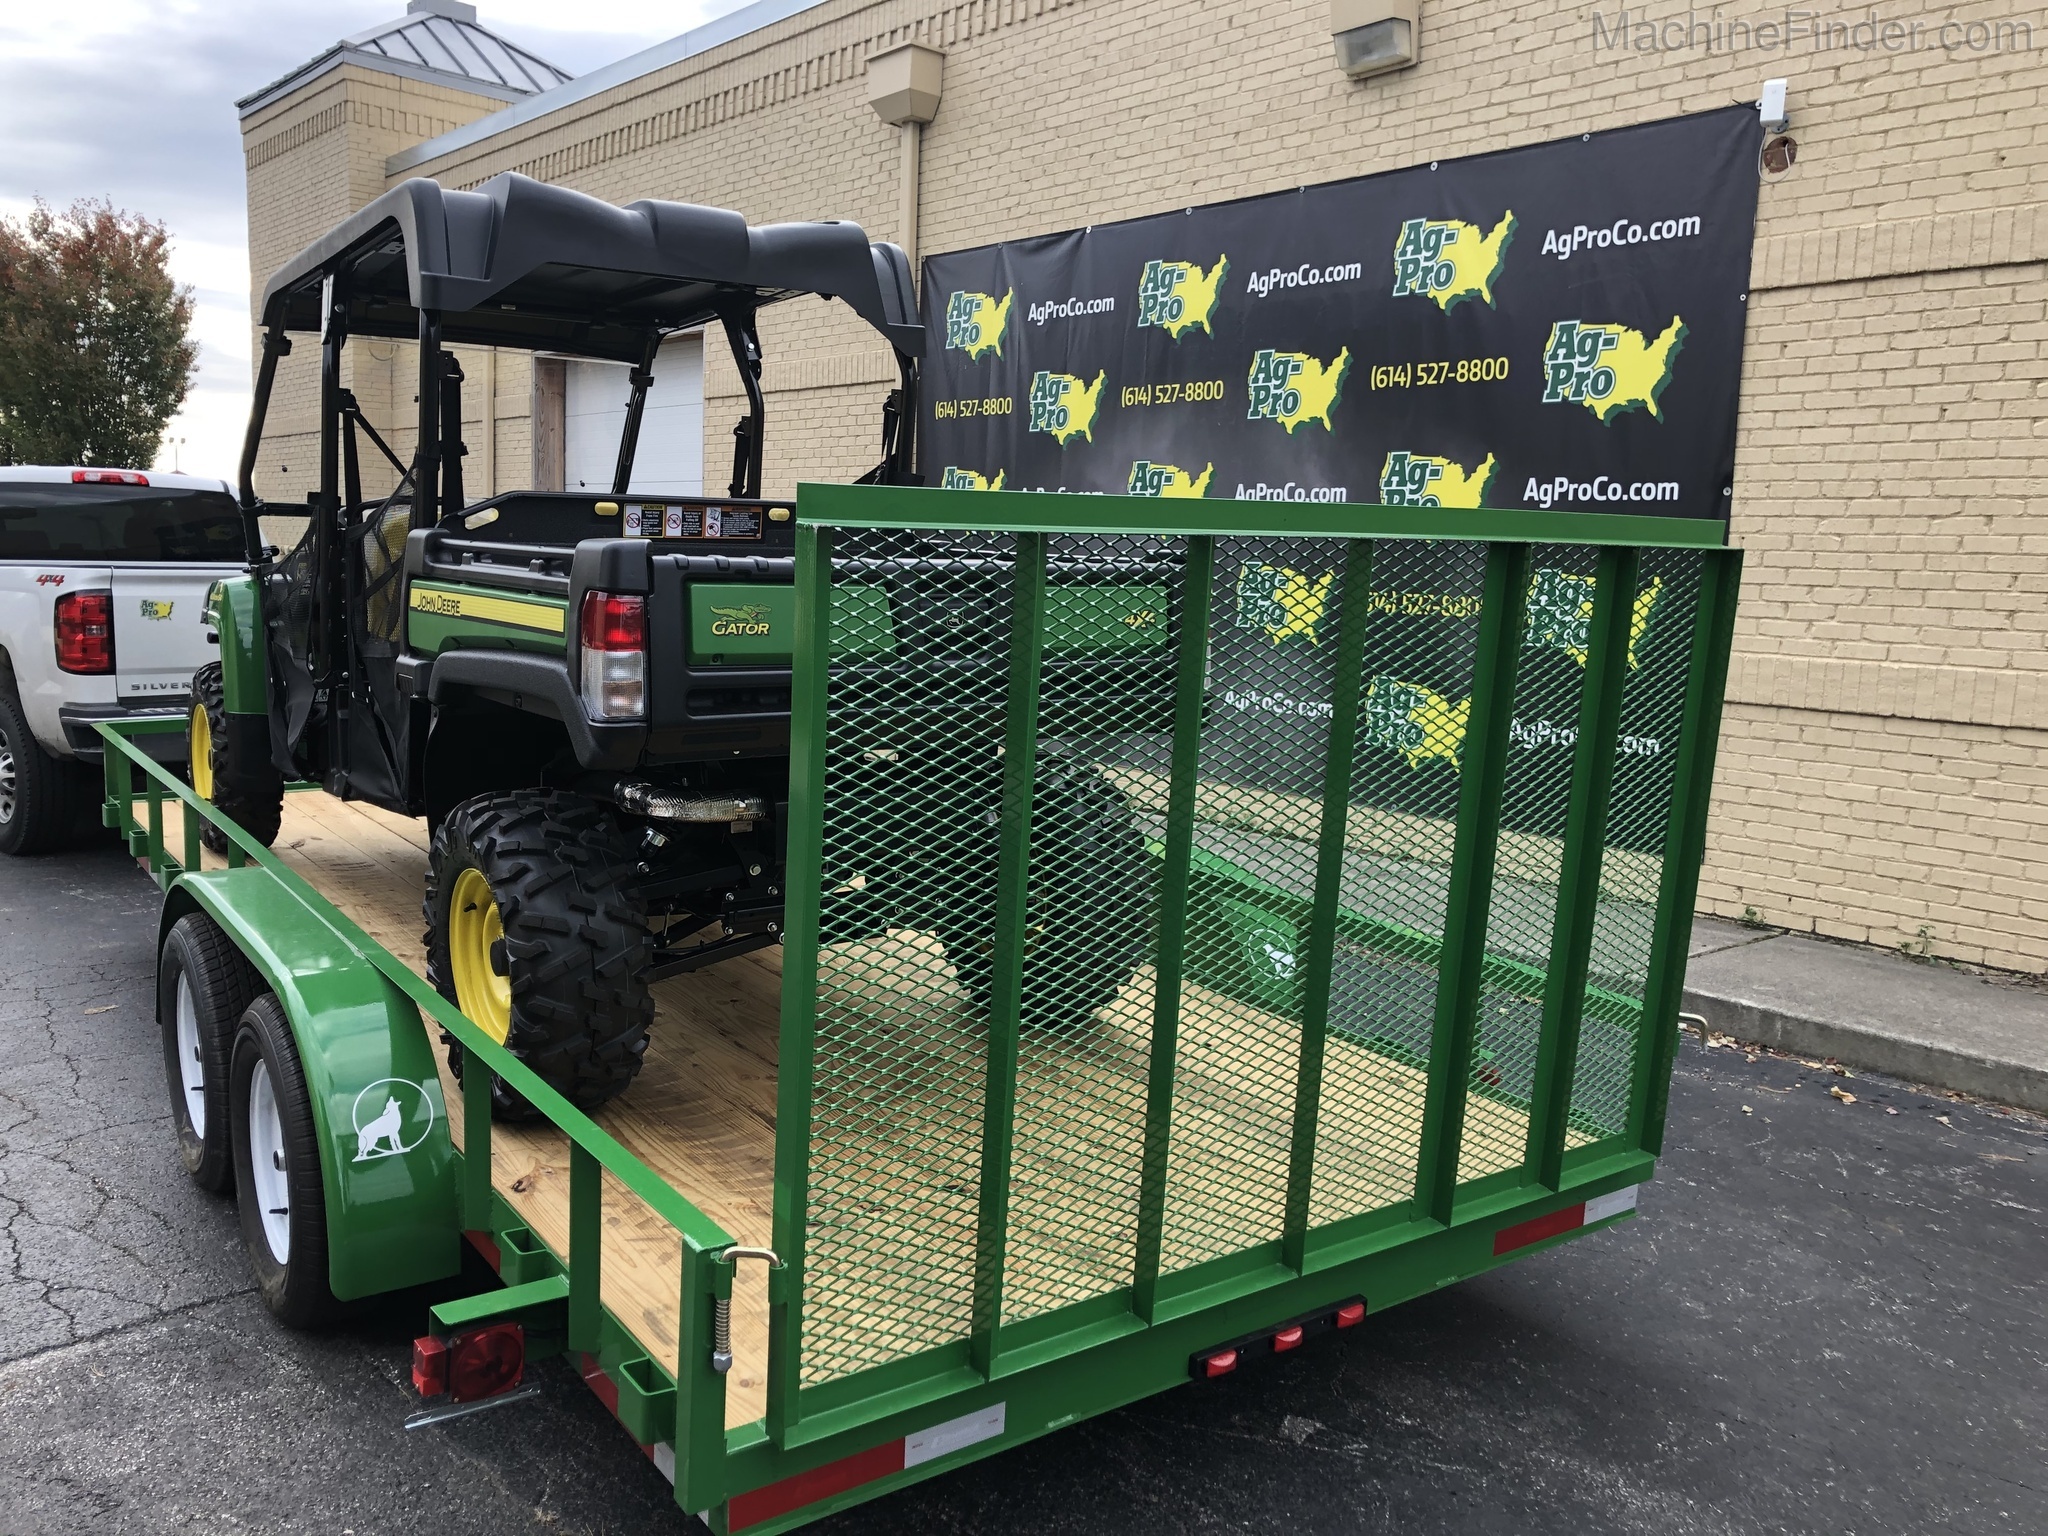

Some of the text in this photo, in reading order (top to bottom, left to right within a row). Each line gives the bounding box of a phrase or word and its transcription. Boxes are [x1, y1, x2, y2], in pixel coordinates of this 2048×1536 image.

[1400, 218, 1460, 262] Ag-
[1541, 215, 1701, 260] AgProCo.com
[1141, 259, 1188, 298] Ag-
[1247, 262, 1362, 298] AgProCo.com
[1392, 257, 1456, 297] Pro
[949, 291, 983, 324] Ag-
[1028, 296, 1115, 326] AgProCo.com
[1137, 293, 1185, 328] Pro
[946, 319, 982, 349] Pro
[1547, 320, 1618, 368] Ag-
[1251, 349, 1304, 391] Ag-
[1370, 356, 1509, 391] (614) 527-8800
[1543, 361, 1616, 403] Pro
[1032, 371, 1071, 405] Ag-
[1121, 380, 1224, 408] (614) 527-8800
[1247, 384, 1301, 420] Pro
[935, 397, 1013, 421] (614) 527-8800
[1029, 402, 1069, 432] Pro
[1130, 460, 1176, 497] Ag-
[1381, 452, 1443, 496] Ag-
[1235, 482, 1347, 502] AgProCo.com
[1523, 476, 1680, 509] AgProCo.com
[141, 609, 159, 617] Pro
[417, 592, 461, 615] JOHN DEERE
